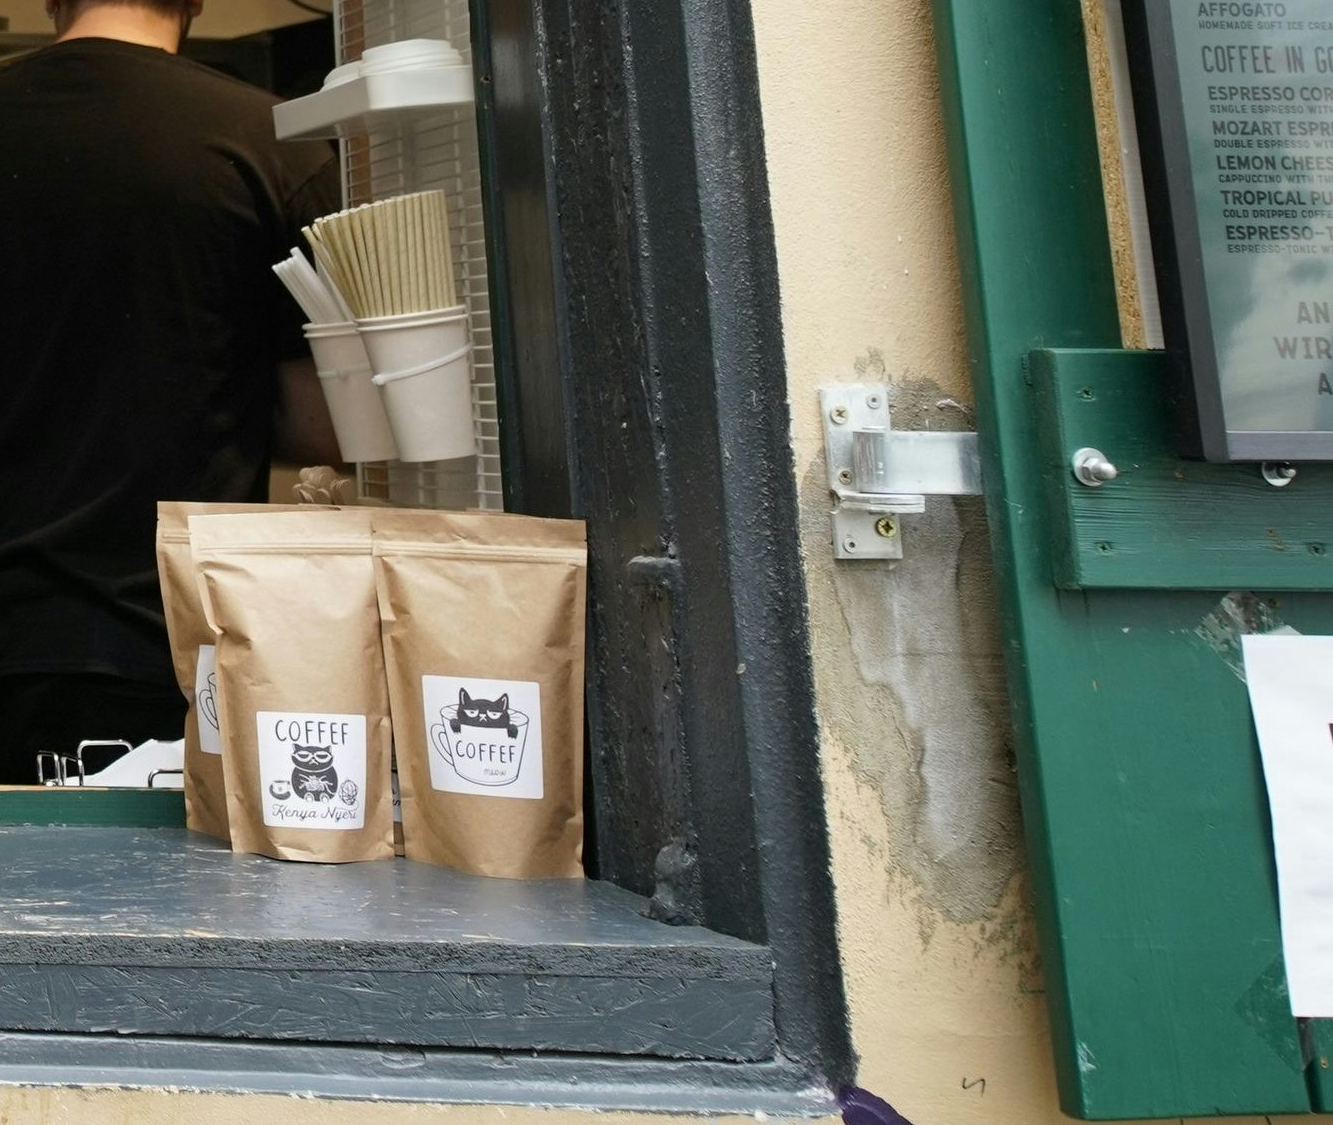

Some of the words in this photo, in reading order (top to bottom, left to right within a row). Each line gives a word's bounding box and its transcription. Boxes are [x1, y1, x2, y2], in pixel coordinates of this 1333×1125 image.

[1198, 2, 1286, 17] AFFOGATO
[1201, 45, 1276, 73] COFFEE
[1285, 45, 1305, 73] IN
[1207, 86, 1295, 101] ESPRESSO
[1209, 104, 1248, 114] SINGLE
[1251, 104, 1304, 114] ESPRESSO
[1212, 120, 1282, 136] MOZART
[1214, 139, 1253, 148] DOUBLE
[1257, 139, 1310, 149] ESPRESSO
[1216, 155, 1276, 170] LEMON
[1218, 174, 1282, 183] CAPPUCCINO
[1220, 190, 1306, 205] TROPICAL
[1223, 209, 1249, 218] COLD
[1252, 209, 1298, 219] DRIPPED
[271, 803, 319, 821] Kenya
